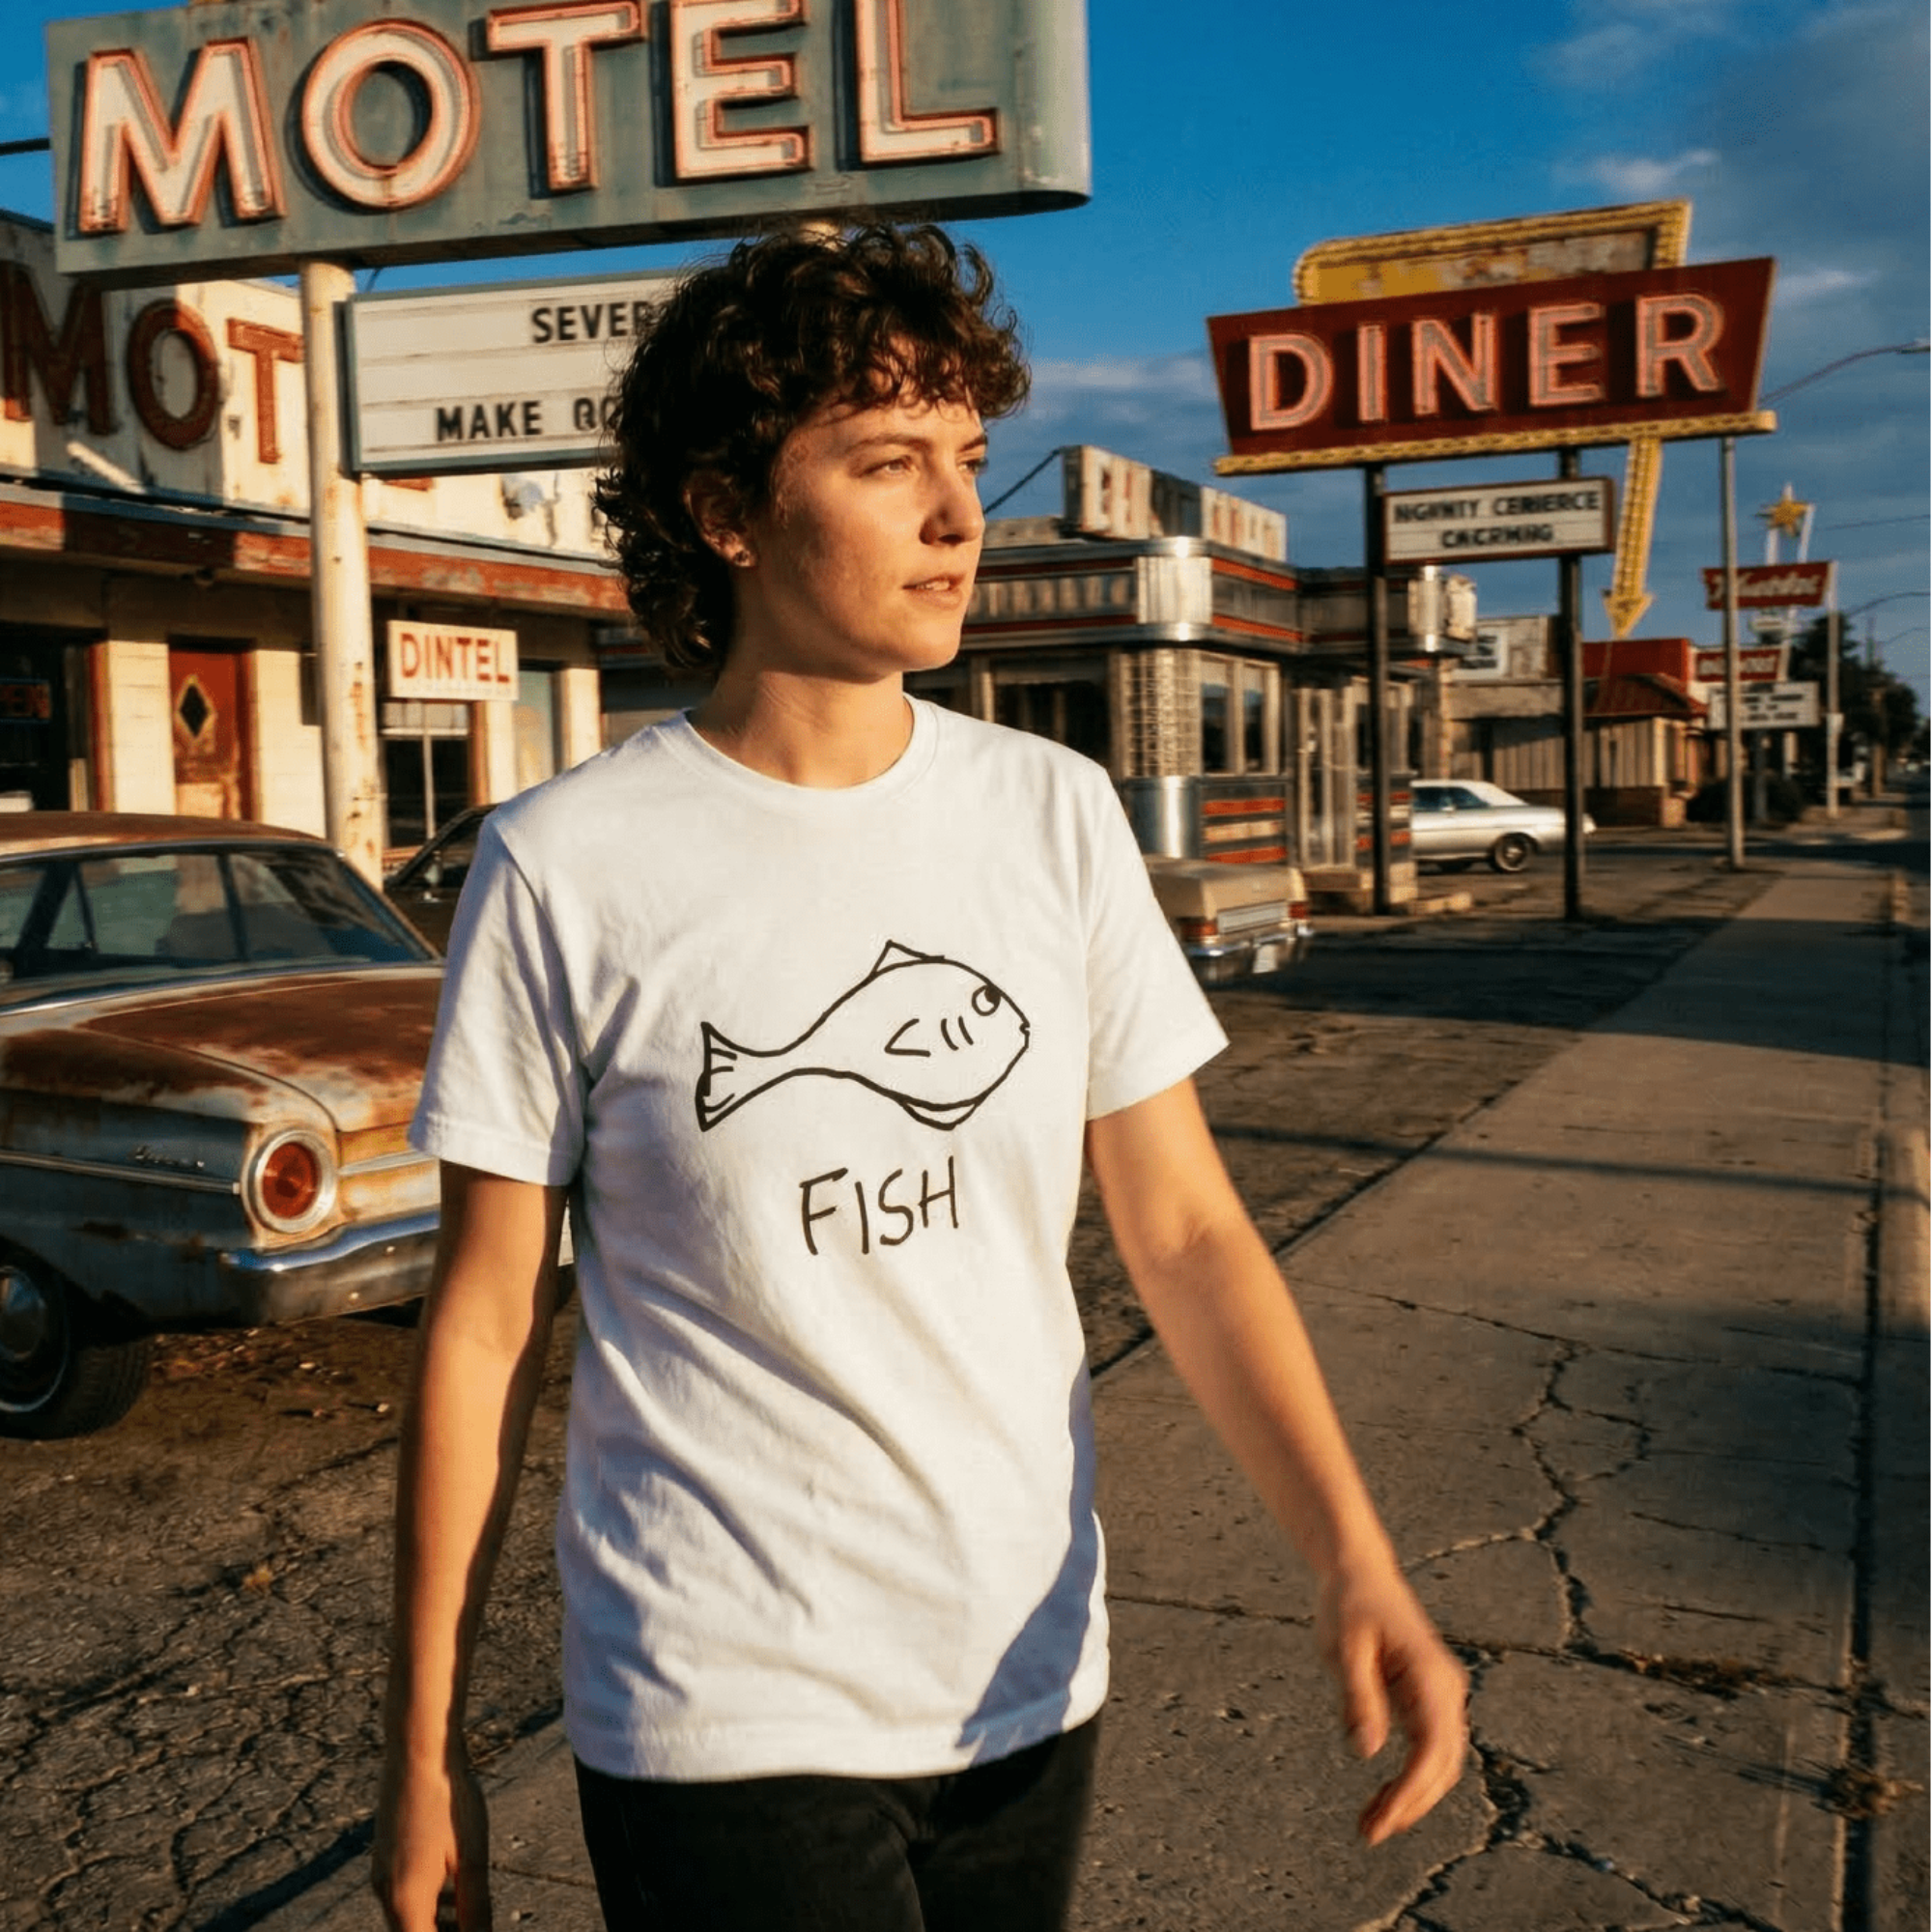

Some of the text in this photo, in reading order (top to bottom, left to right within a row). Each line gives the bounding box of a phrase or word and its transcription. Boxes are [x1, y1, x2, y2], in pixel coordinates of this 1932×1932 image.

[79, 0, 998, 233] MOTEL
[0, 259, 307, 464] MOT
[436, 400, 543, 441] MAKE
[1249, 293, 1728, 432] DINER
[400, 632, 511, 684] DINTEL
[799, 1155, 958, 1256] FISH
